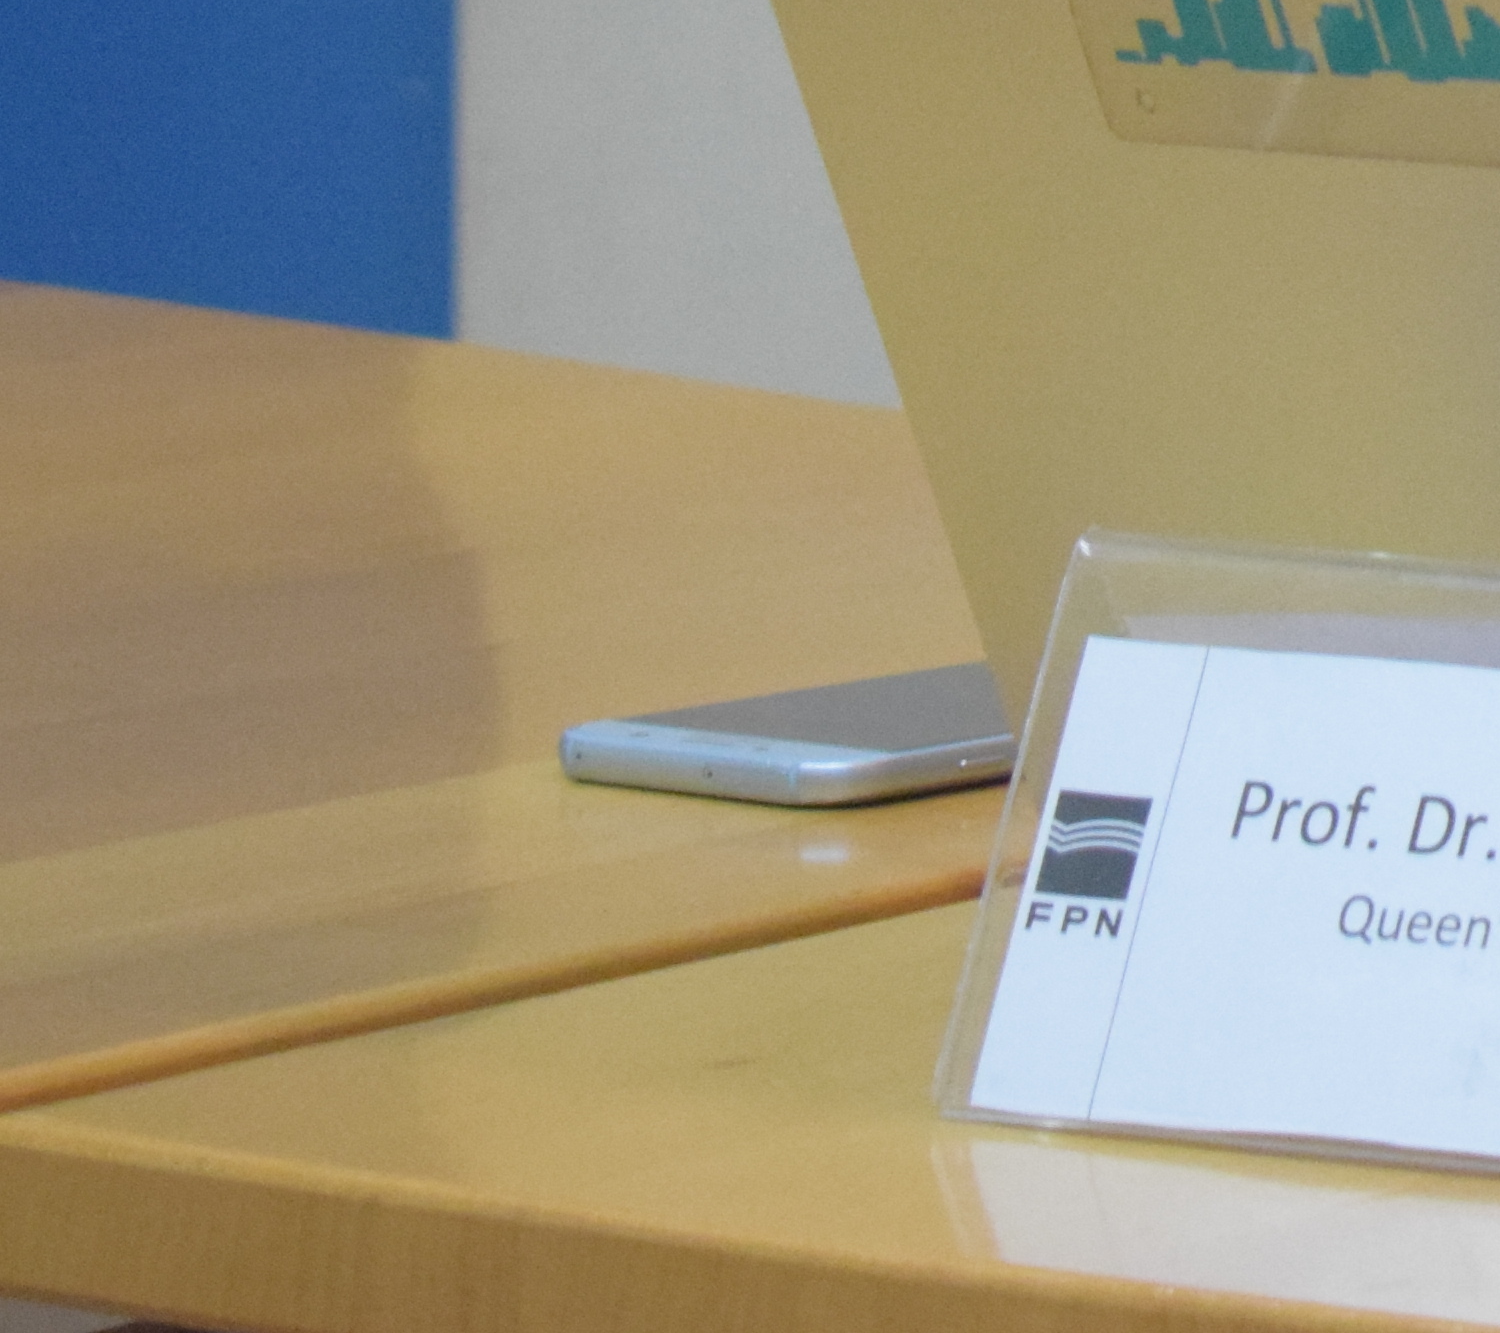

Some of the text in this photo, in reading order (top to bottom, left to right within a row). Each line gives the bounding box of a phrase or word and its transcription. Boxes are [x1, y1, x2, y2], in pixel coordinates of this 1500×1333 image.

[1230, 779, 1378, 851] Prof.
[1407, 794, 1498, 862] Dr.
[1024, 900, 1124, 939] FPN
